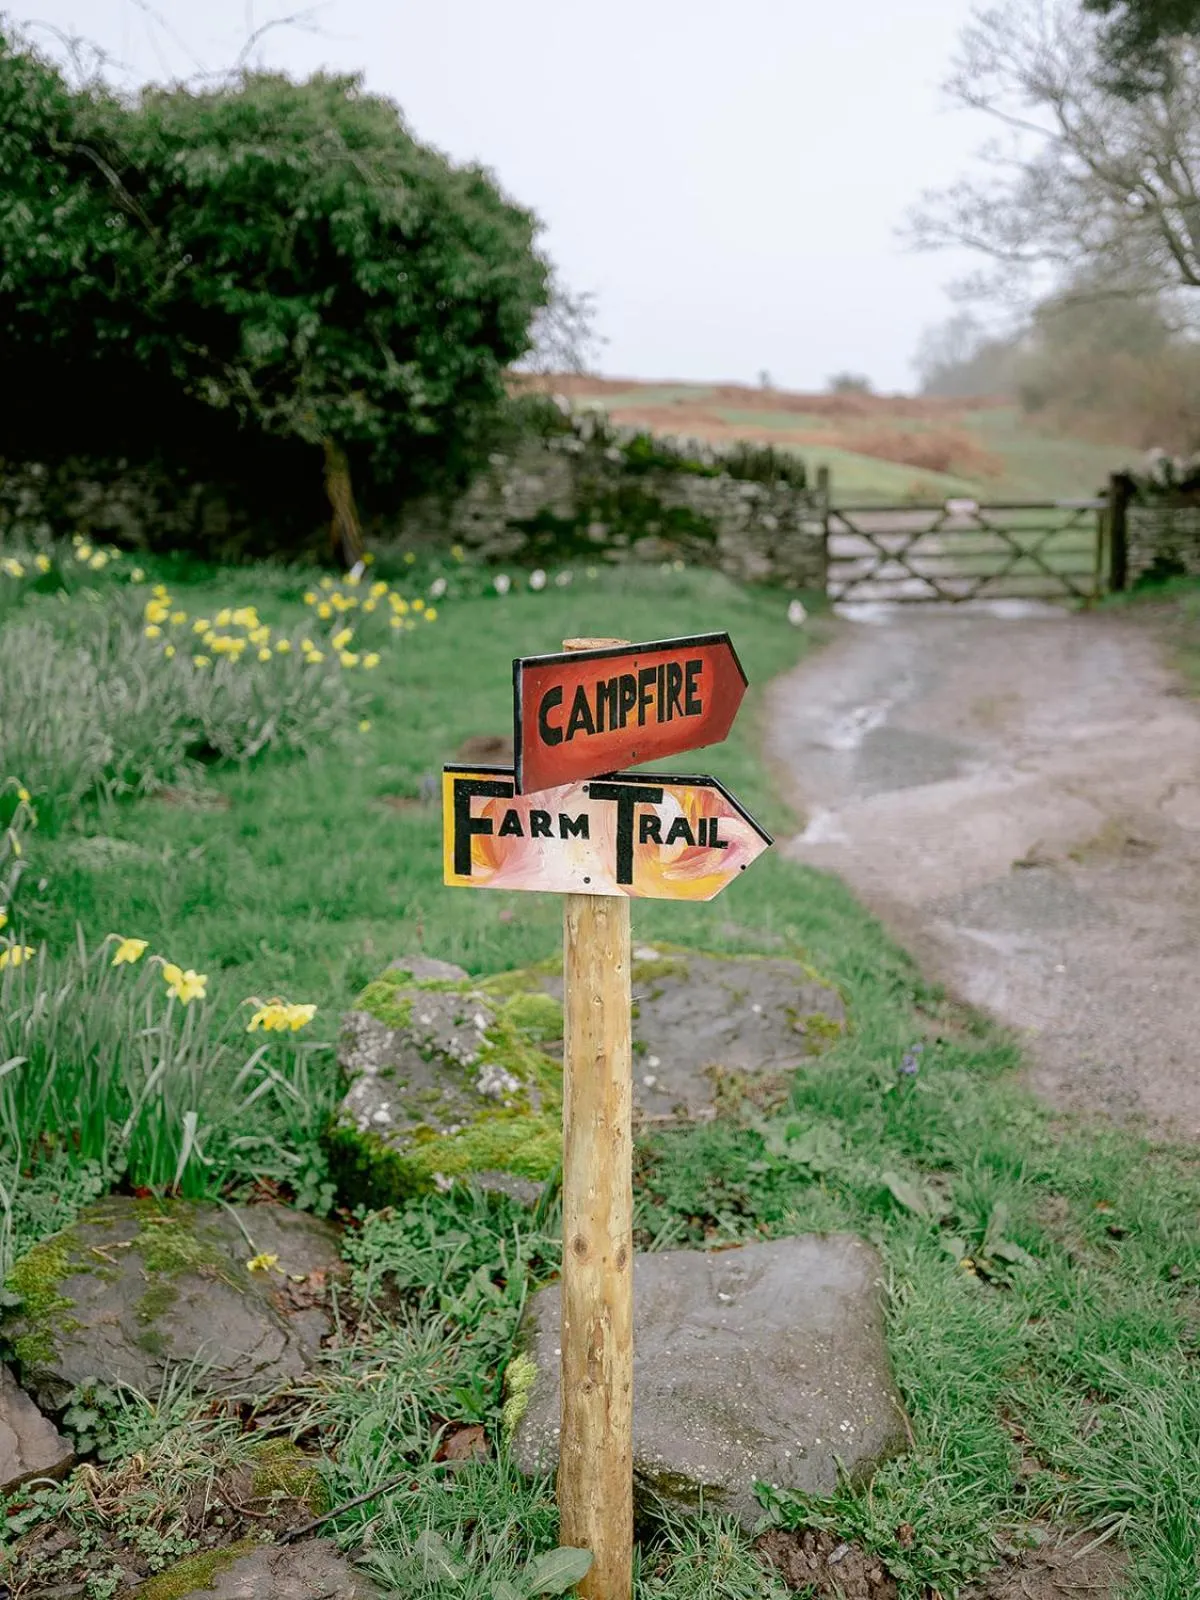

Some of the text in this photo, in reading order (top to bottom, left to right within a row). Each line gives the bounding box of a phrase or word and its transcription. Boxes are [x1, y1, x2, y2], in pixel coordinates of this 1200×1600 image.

[538, 659, 703, 746] CAMPFIRE
[453, 778, 728, 885] FARM TRAIL
